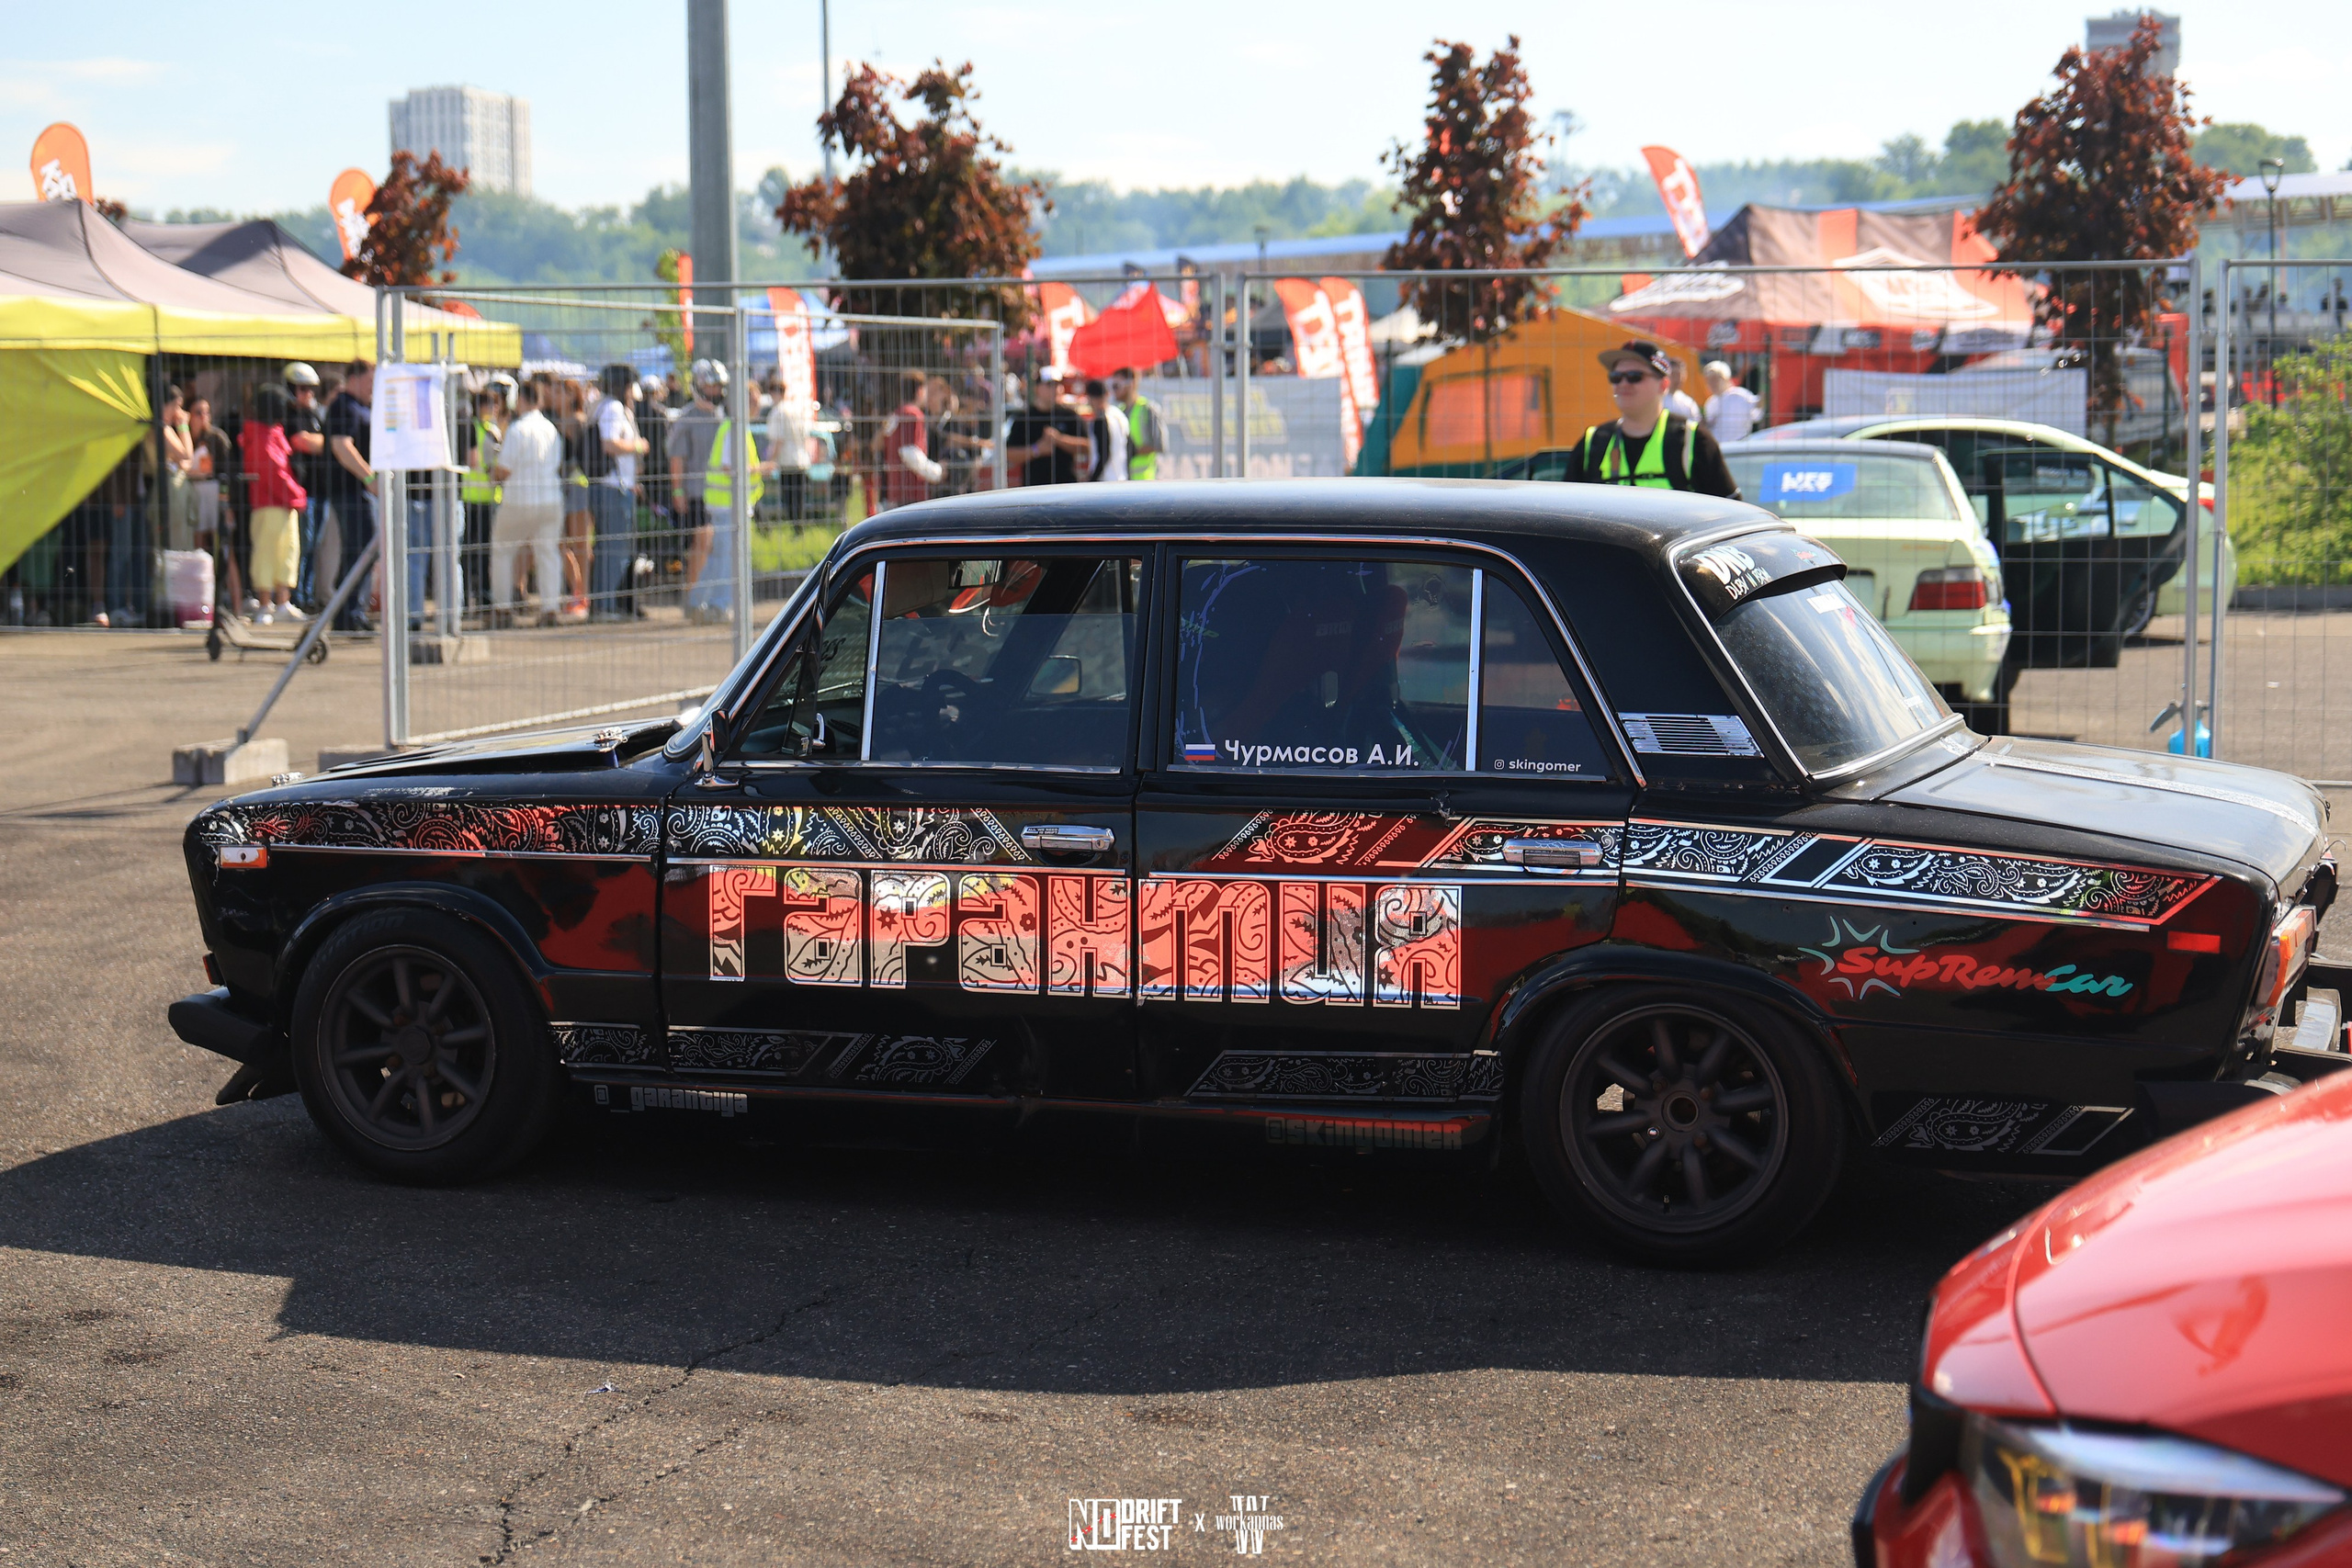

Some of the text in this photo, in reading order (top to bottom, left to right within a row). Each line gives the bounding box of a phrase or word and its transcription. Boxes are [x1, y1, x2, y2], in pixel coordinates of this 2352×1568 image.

[1224, 739, 1420, 766] Чурмасов А.И.
[1508, 758, 1582, 773] skingomer
